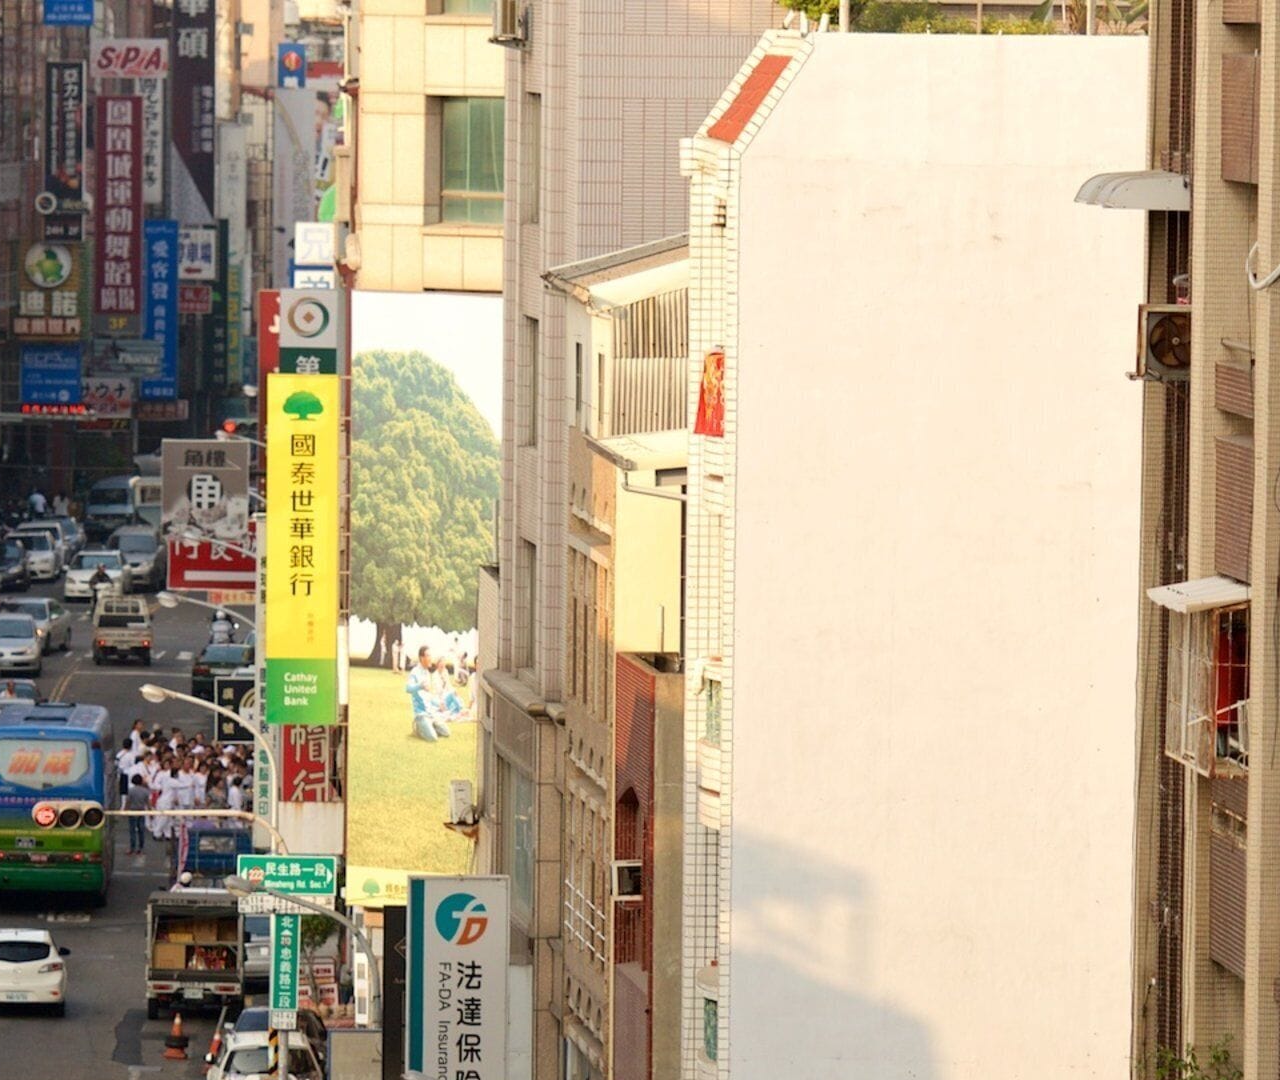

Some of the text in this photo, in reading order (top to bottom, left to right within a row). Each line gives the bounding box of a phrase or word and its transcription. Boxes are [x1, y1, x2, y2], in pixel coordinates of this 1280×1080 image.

[290, 434, 316, 597] 國泰世華銀行
[284, 672, 318, 684] Cathay
[284, 685, 317, 695] United
[284, 696, 308, 706] Bank
[265, 862, 327, 877] 民生路一段
[438, 961, 452, 1012] FA-DA
